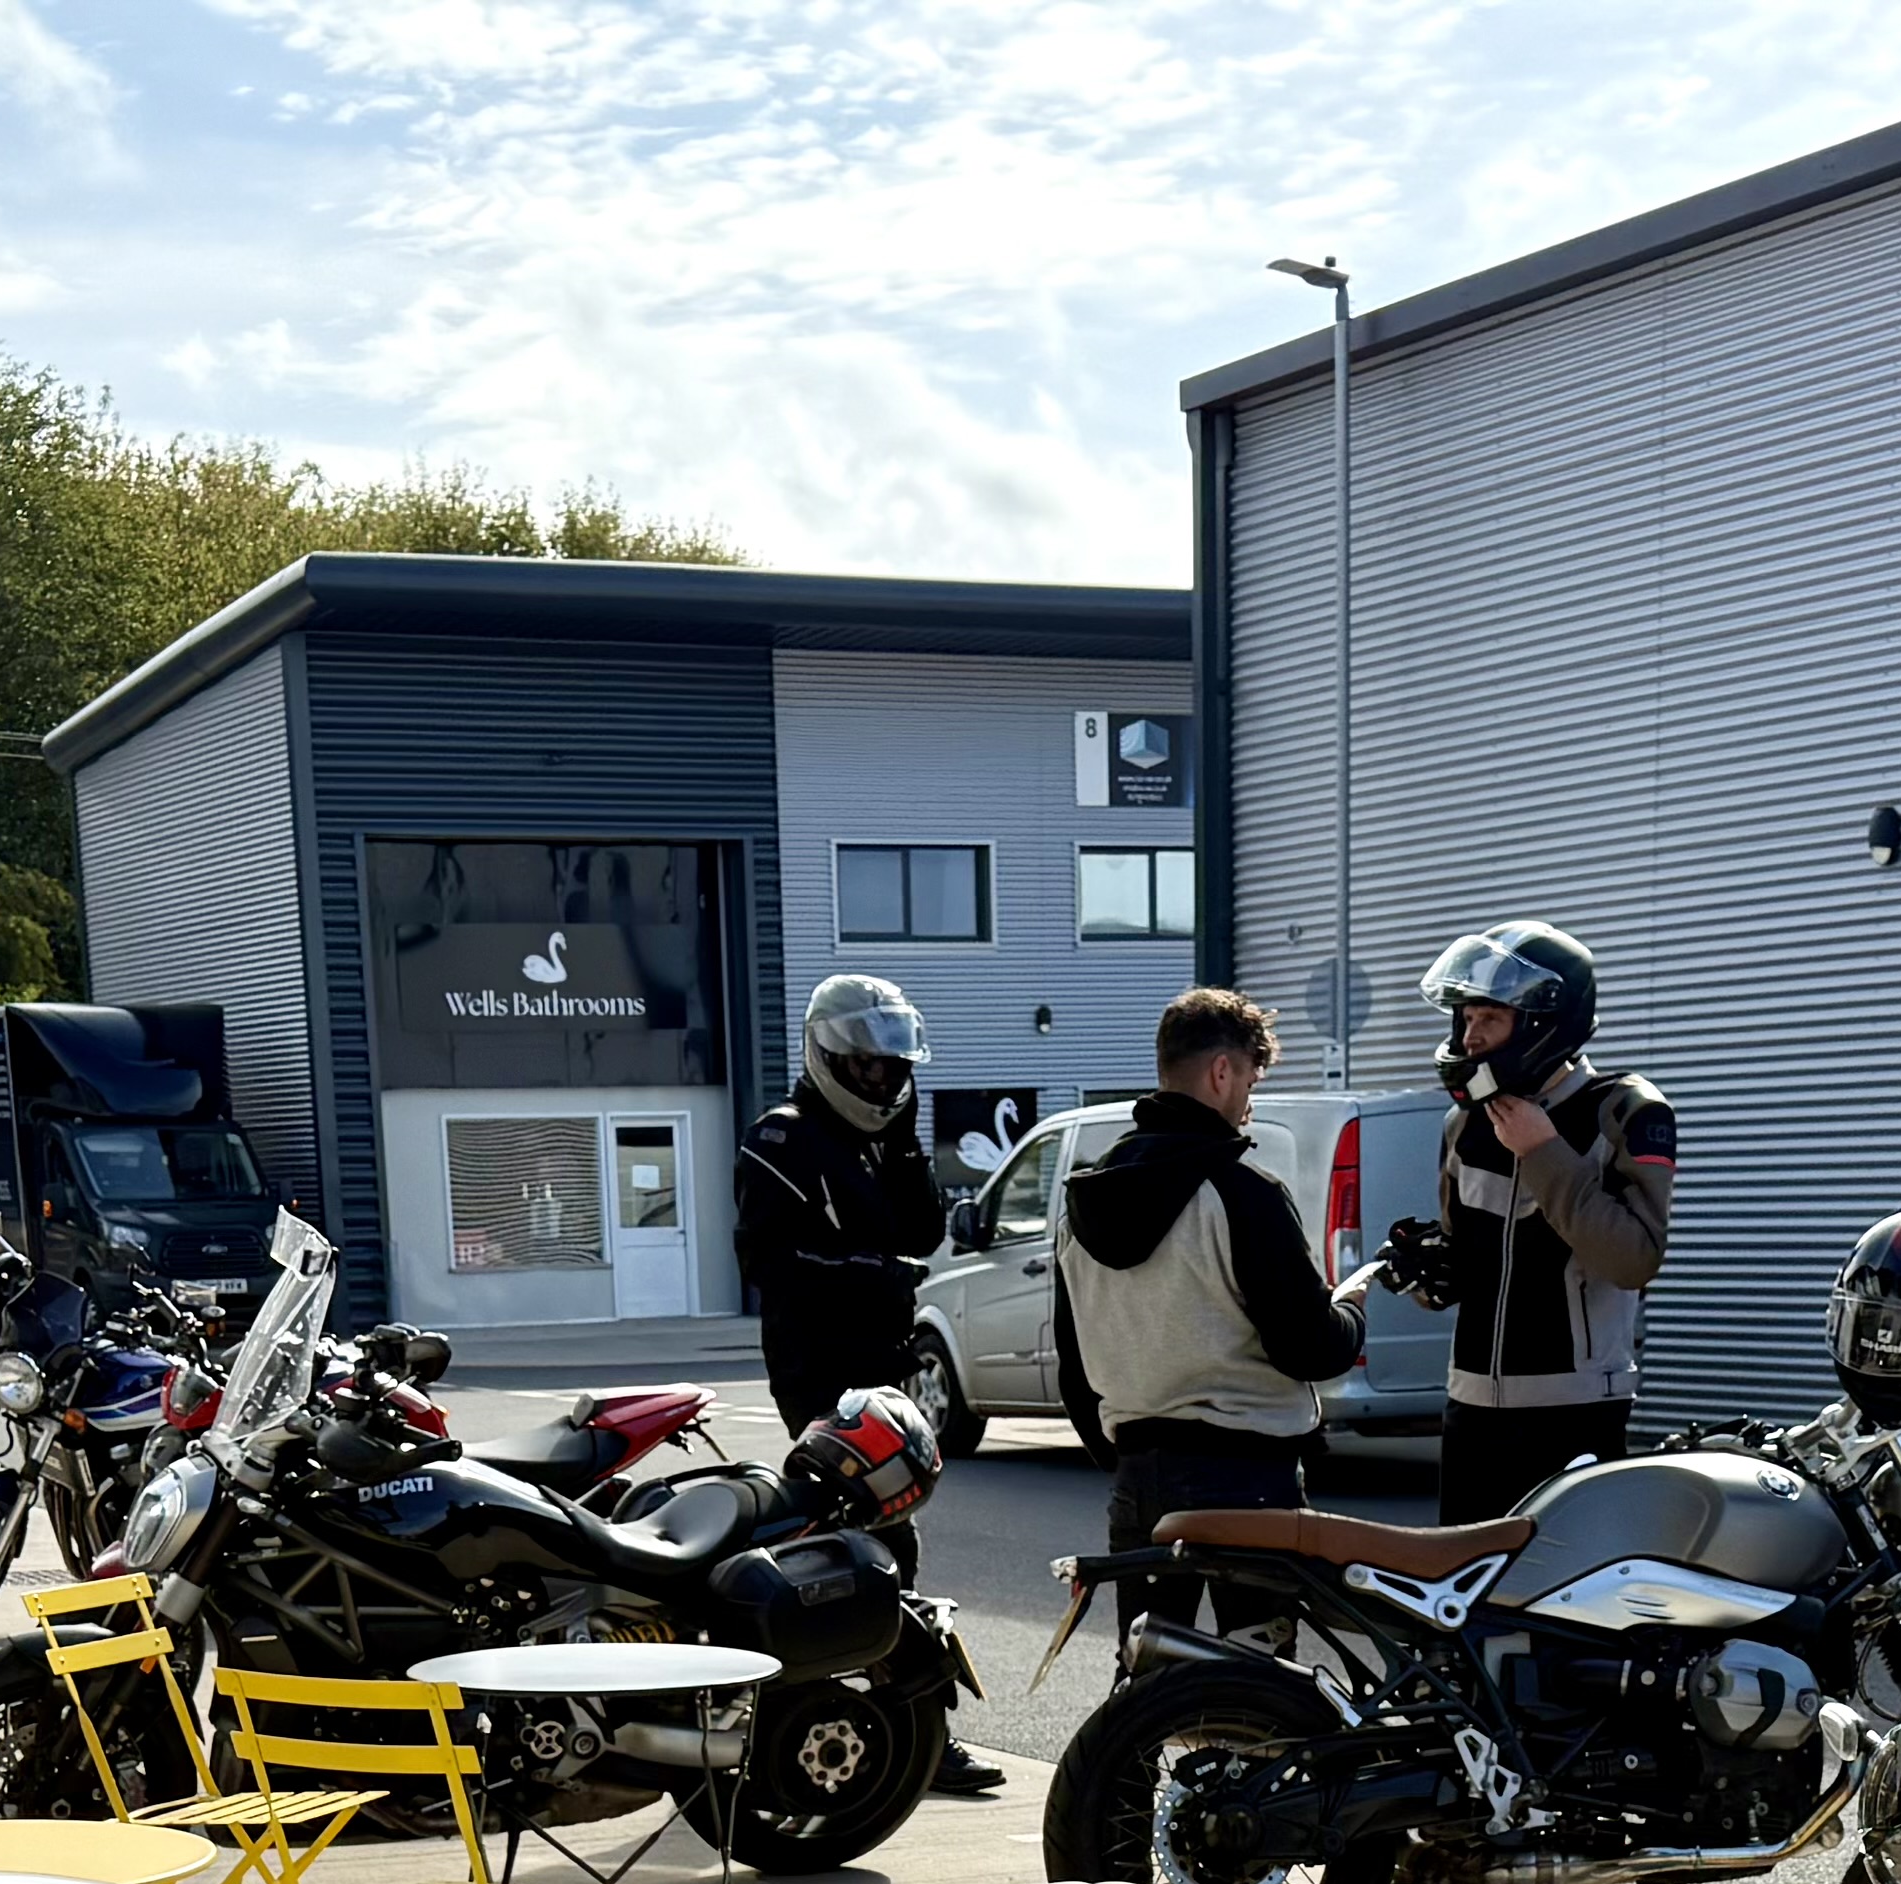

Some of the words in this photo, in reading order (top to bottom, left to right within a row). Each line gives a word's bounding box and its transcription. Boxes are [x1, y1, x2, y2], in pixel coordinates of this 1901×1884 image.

[1085, 717, 1097, 738] 8
[445, 989, 509, 1017] Wells
[513, 989, 646, 1017] Bathrooms
[358, 1476, 434, 1503] DUCATI
